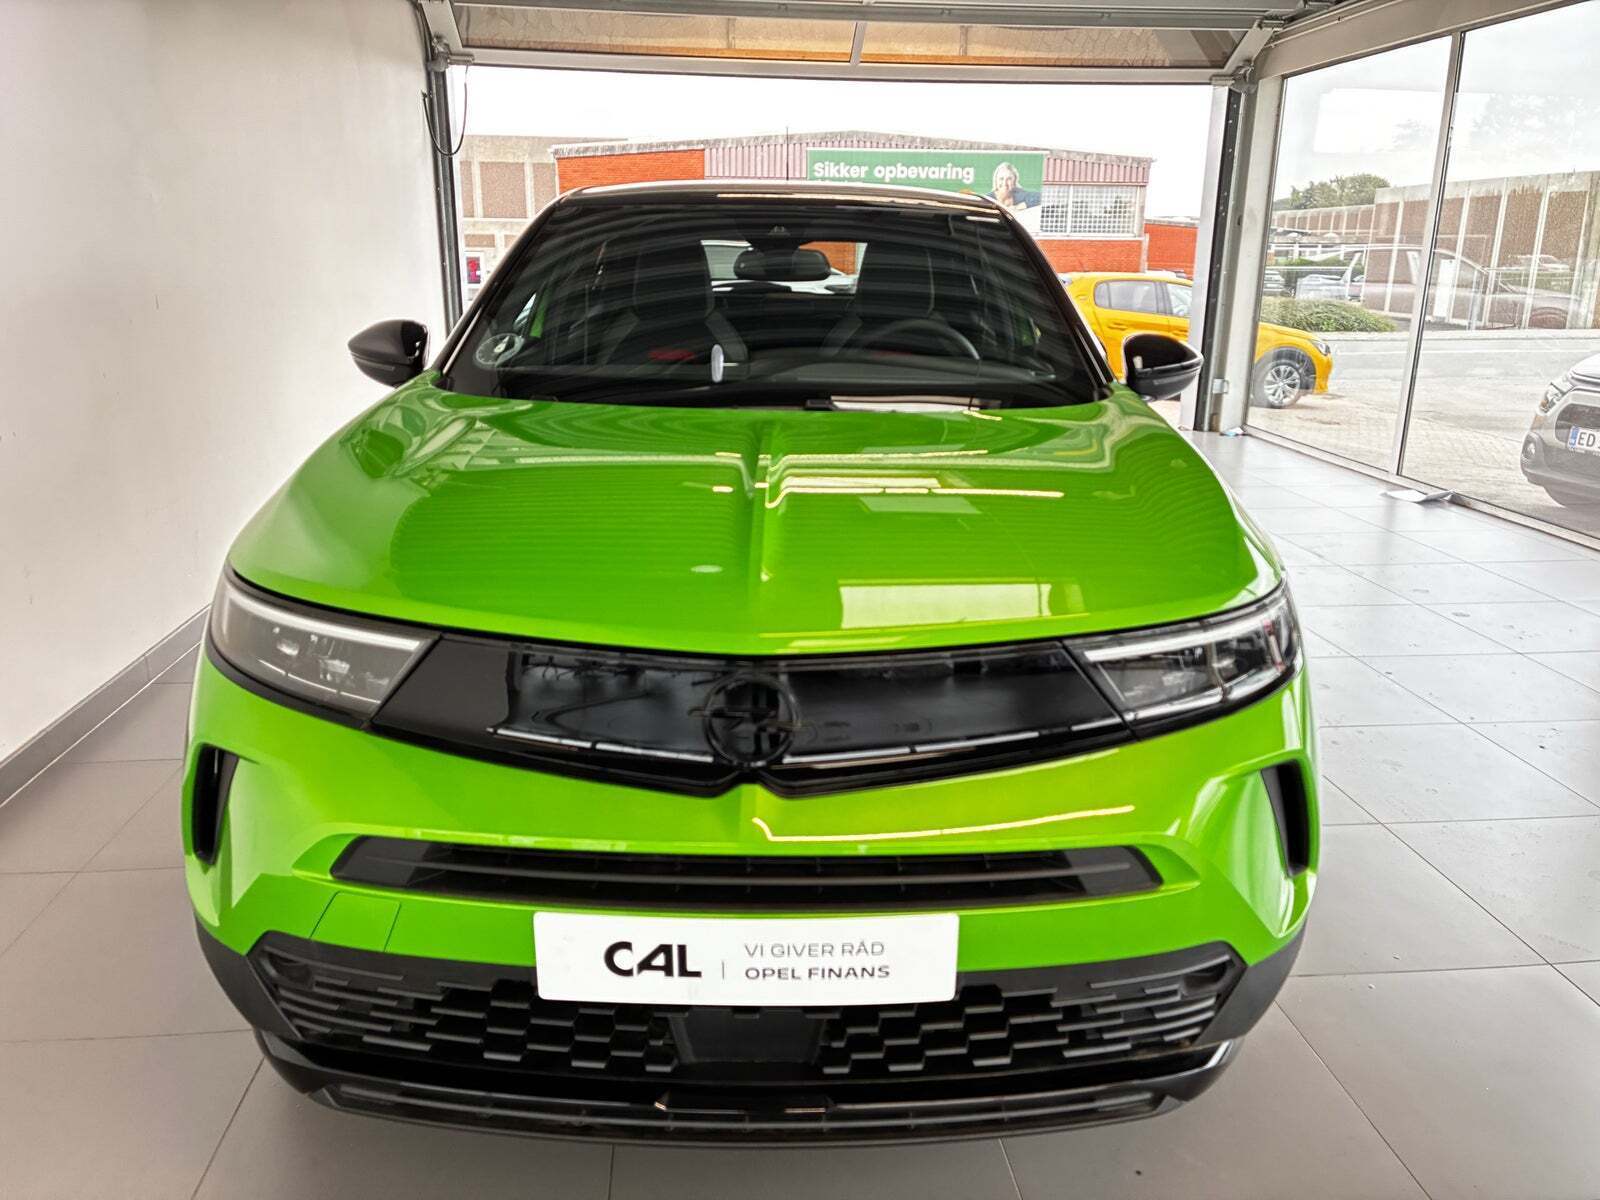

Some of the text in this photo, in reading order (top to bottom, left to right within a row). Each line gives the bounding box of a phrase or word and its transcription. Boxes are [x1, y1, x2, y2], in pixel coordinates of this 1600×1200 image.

[813, 161, 975, 184] Sikker opbevaring
[1577, 431, 1597, 448] ED
[744, 939, 886, 958] VI GIVER RÅD
[603, 940, 702, 978] CAL
[744, 965, 891, 981] OPEL FINANS
